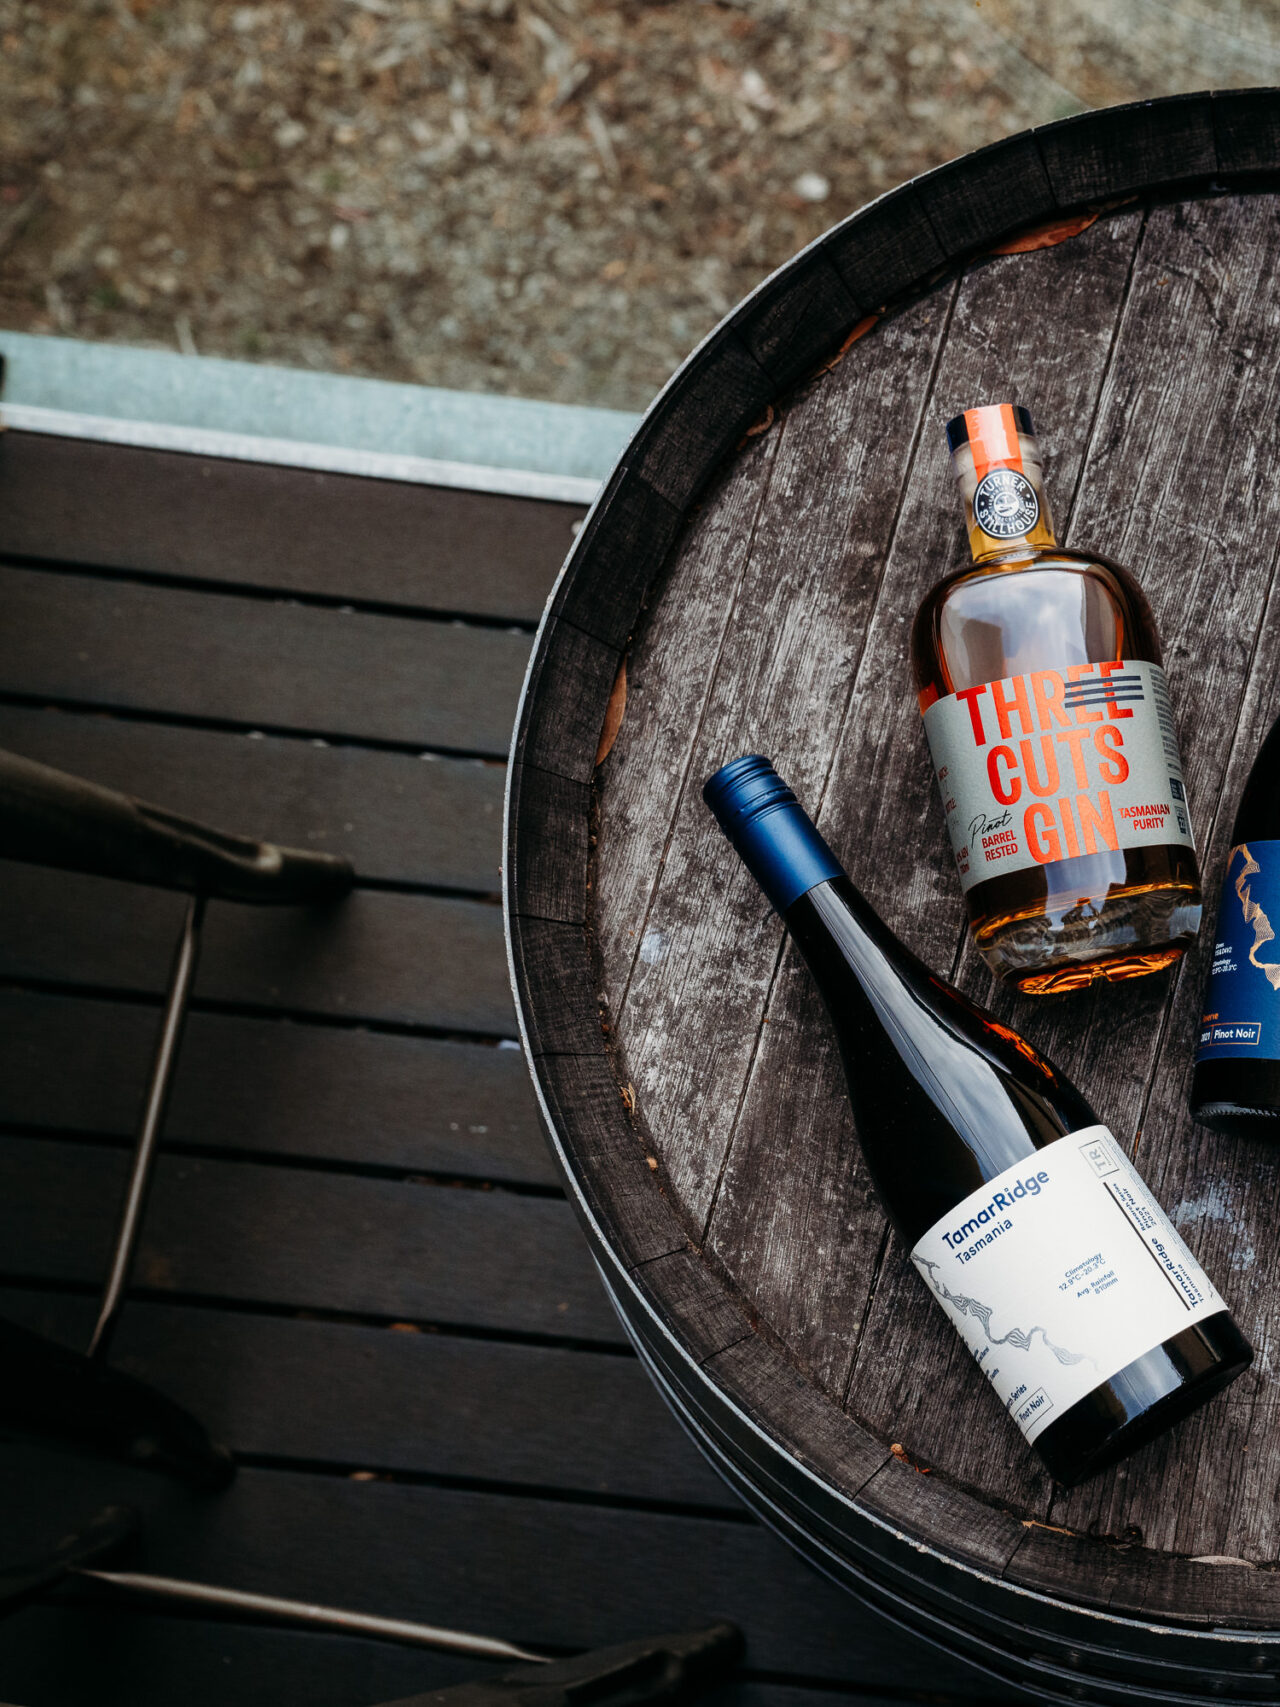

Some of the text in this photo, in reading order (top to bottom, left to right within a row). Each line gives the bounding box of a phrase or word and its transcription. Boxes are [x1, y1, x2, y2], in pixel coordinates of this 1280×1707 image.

[980, 473, 1026, 497] TURNER
[980, 501, 1036, 534] STILLHOUSE
[955, 660, 1134, 747] THREE
[986, 724, 1130, 806] CUTS
[1118, 803, 1171, 819] TASMANIAN
[968, 809, 1013, 849] Pinot
[1023, 791, 1119, 864] GIN
[1133, 817, 1165, 831] PURITY
[981, 829, 1017, 848] BARREL
[984, 843, 1018, 862] RESTED
[1214, 1028, 1234, 1040] Pinot
[1235, 1027, 1256, 1038] Noir
[1088, 1148, 1106, 1171] TR
[1113, 1183, 1127, 1202] Series
[1122, 1187, 1136, 1206] Noir
[941, 1171, 1050, 1250] TamarRidge
[1135, 1207, 1152, 1229] Pinot
[1141, 1206, 1157, 1226] 2021
[955, 1219, 1013, 1265] Tasmania
[1065, 1252, 1102, 1278] Climatology
[1151, 1237, 1198, 1308] TamarRidge
[1090, 1270, 1115, 1288] Rainfall
[1178, 1264, 1205, 1302] Tasmania
[1010, 1384, 1028, 1401] Series
[1029, 1395, 1045, 1411] Noir
